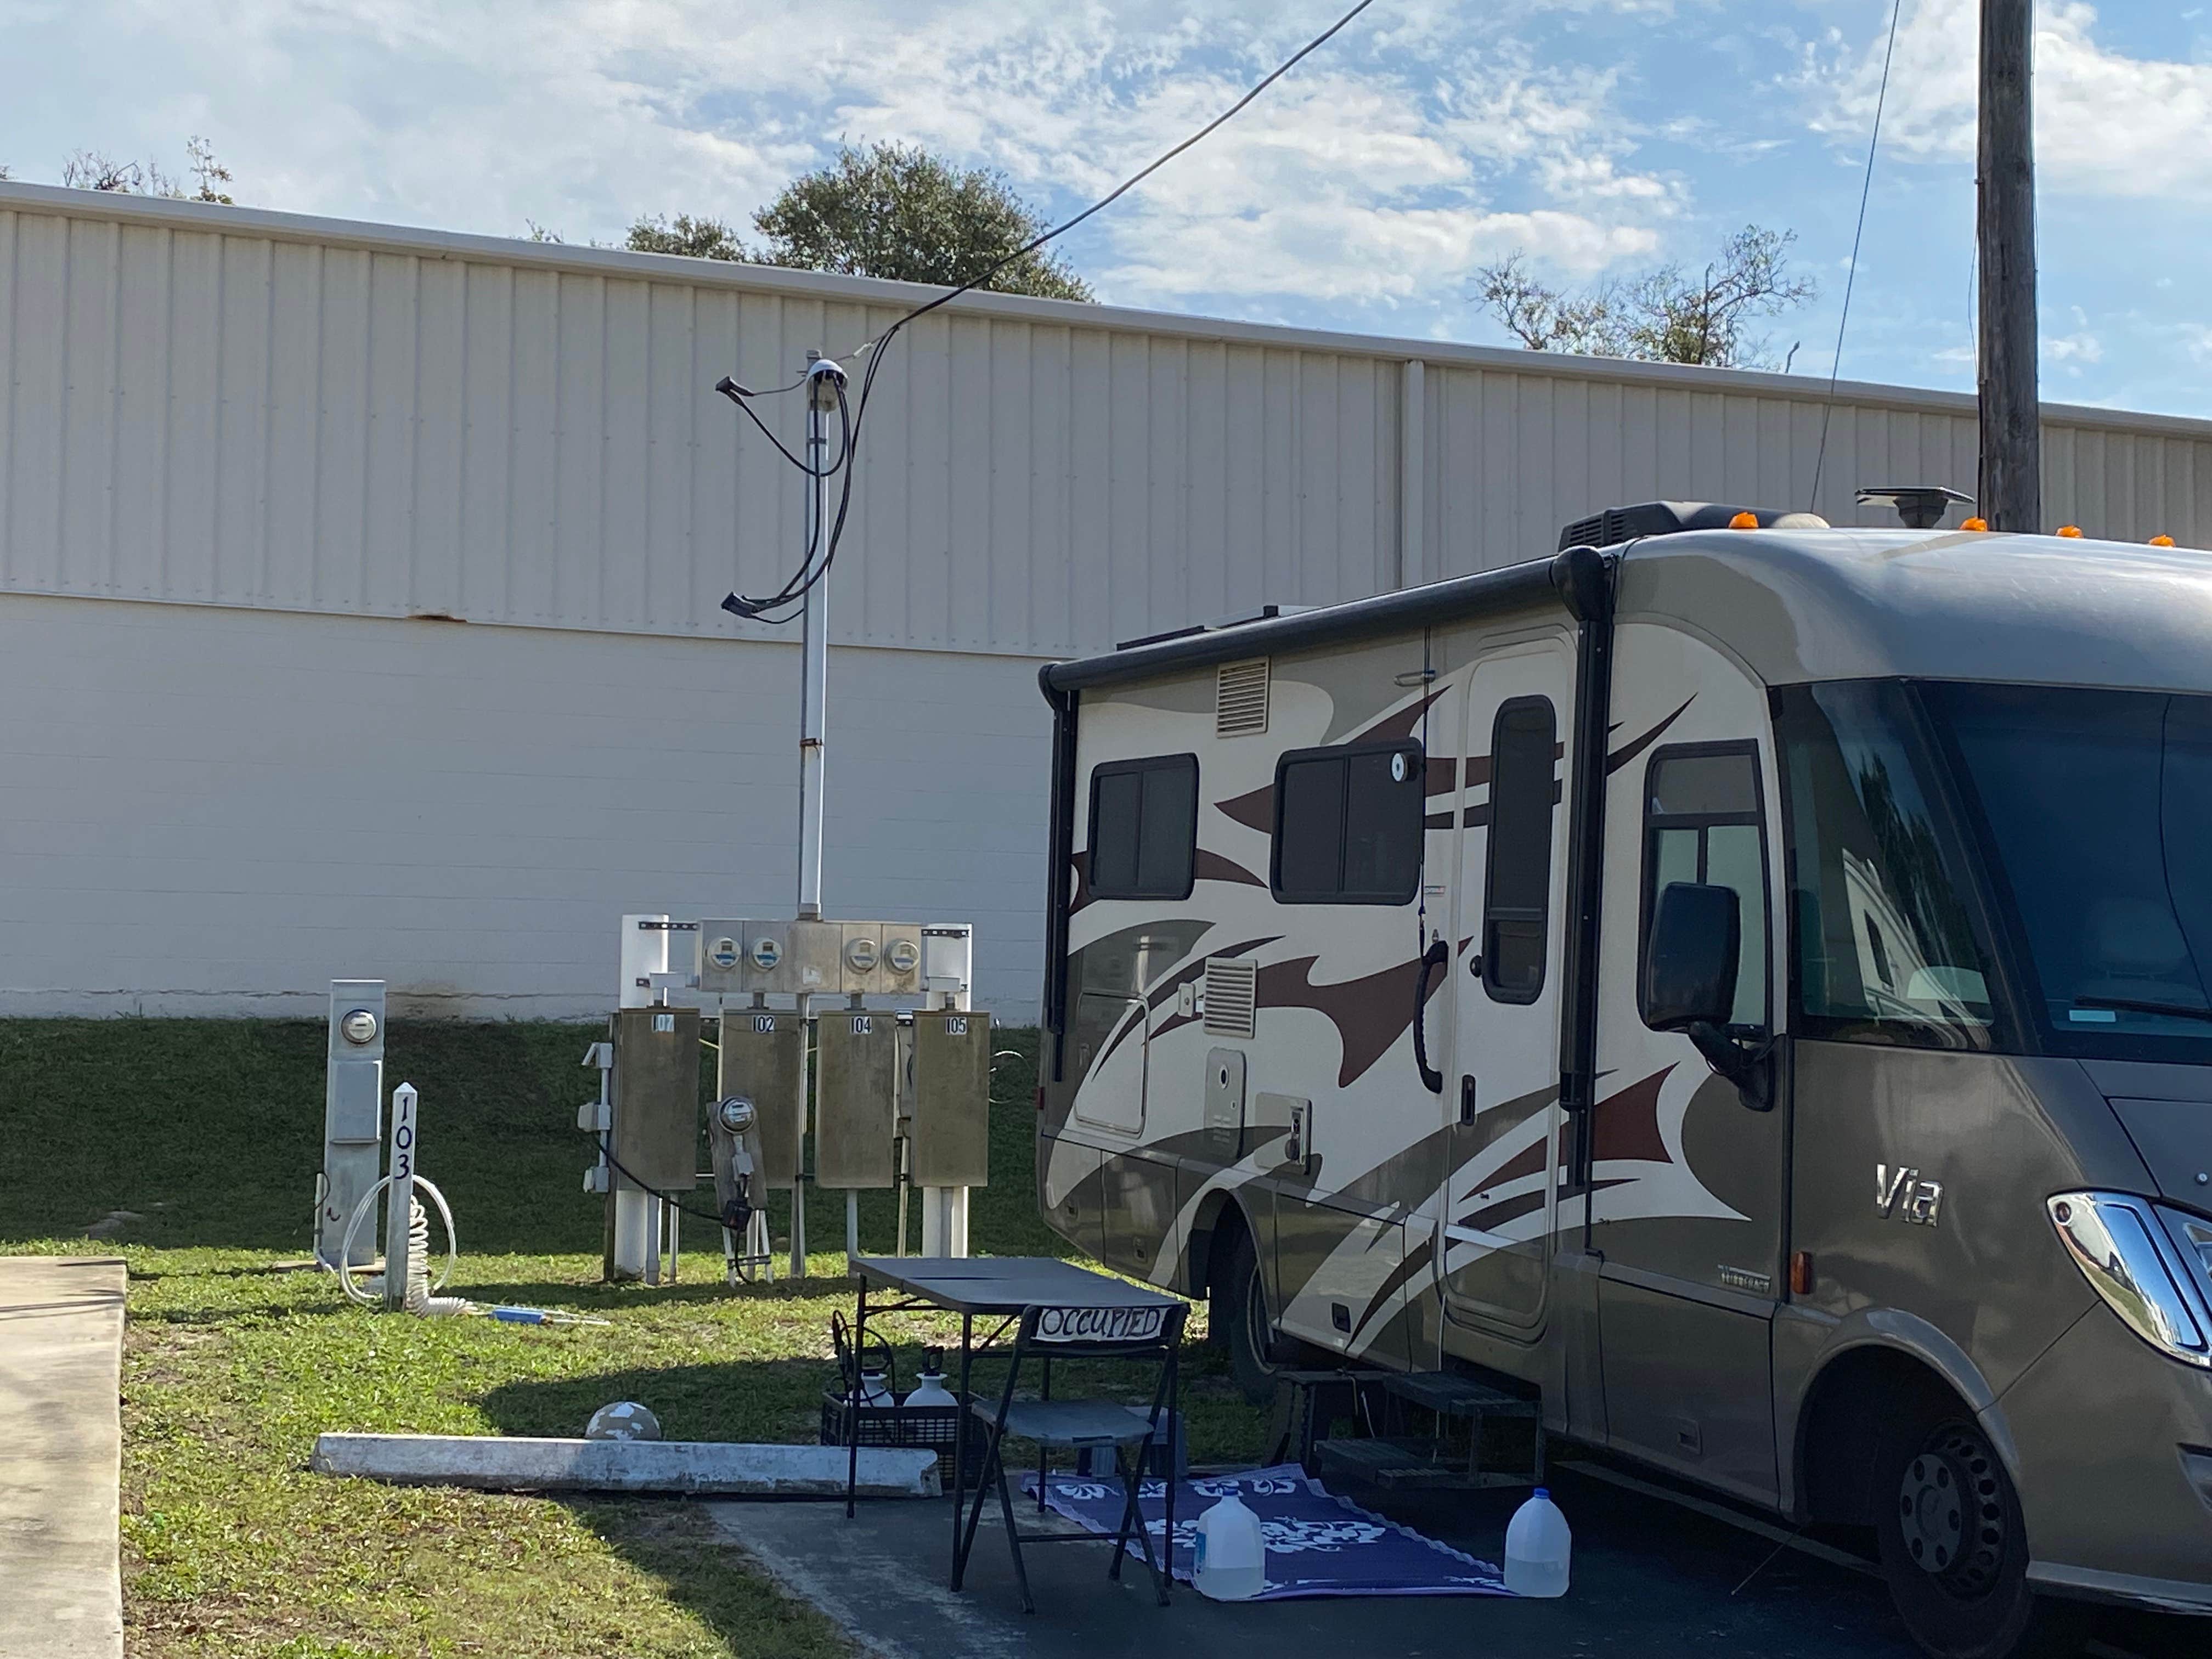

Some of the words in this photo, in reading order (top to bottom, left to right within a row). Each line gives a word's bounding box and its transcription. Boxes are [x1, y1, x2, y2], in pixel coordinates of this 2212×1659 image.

[753, 1016, 774, 1032] 102
[851, 1017, 872, 1033] 104
[947, 1017, 966, 1033] 105
[394, 1096, 412, 1180] 103
[1876, 1164, 1943, 1227] Via
[1042, 1308, 1161, 1338] OCCUPIED
